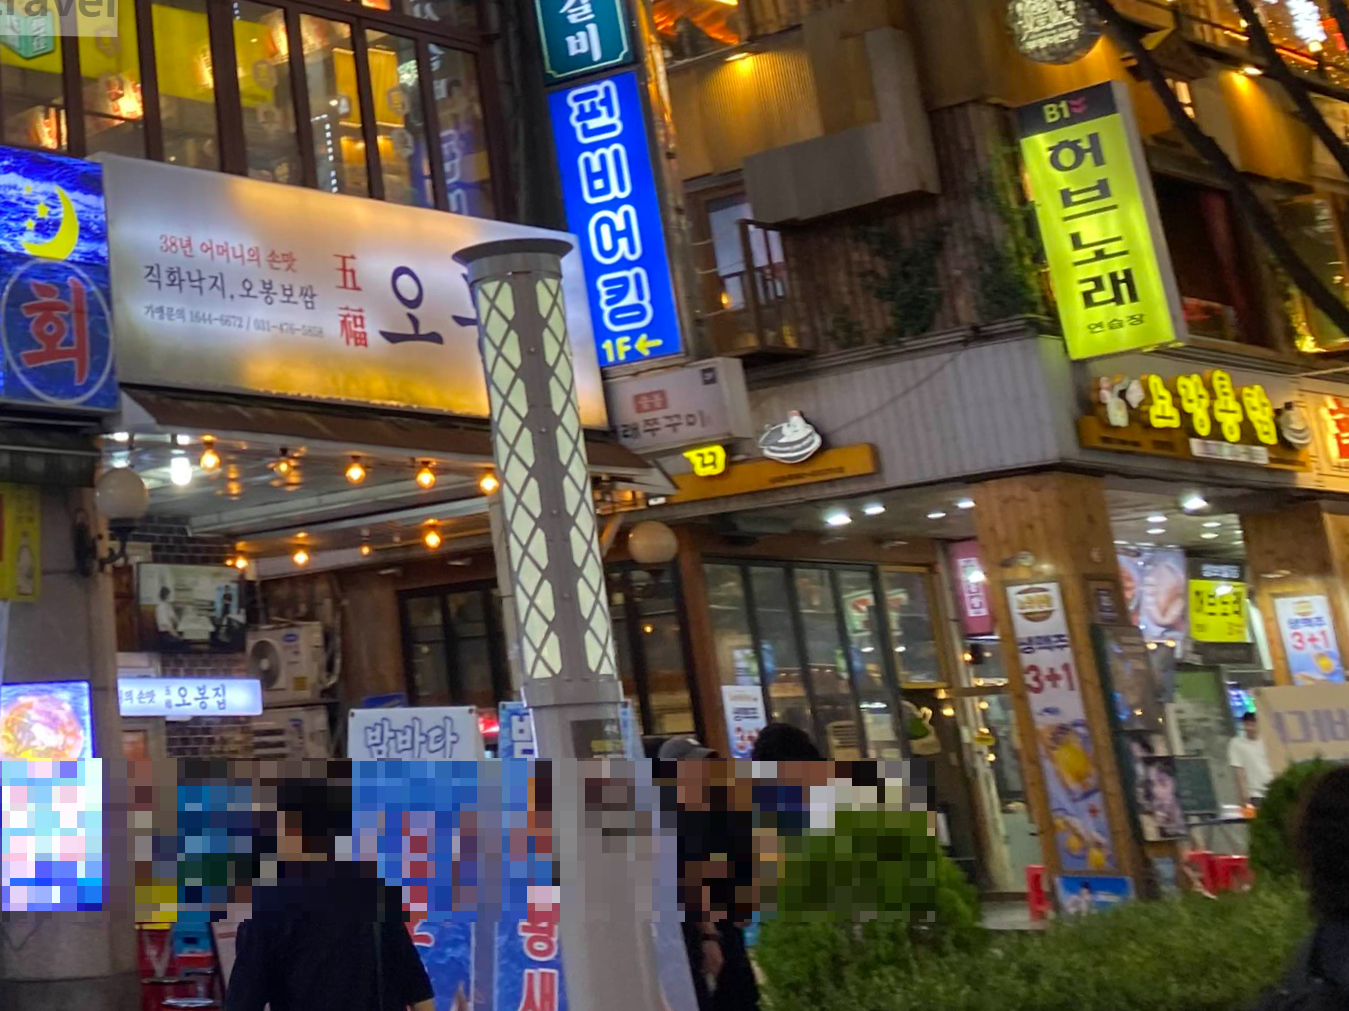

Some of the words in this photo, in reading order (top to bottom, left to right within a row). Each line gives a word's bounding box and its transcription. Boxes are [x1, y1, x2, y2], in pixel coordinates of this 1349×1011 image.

[1043, 102, 1072, 124] B1
[1048, 131, 1140, 310] 허브노래
[158, 234, 195, 259] 38년
[199, 239, 263, 268] 어머니의
[265, 249, 299, 274] 손맛
[238, 277, 318, 310] 오봉보쌈
[332, 253, 370, 350] 五福
[143, 302, 187, 323] 가맹문의
[1087, 312, 1145, 335] 연습장
[19, 276, 92, 386] 회
[601, 336, 633, 363] 1F
[1290, 630, 1330, 651] 3+1
[1023, 662, 1076, 695] 3+1
[174, 683, 227, 711] 오봉집
